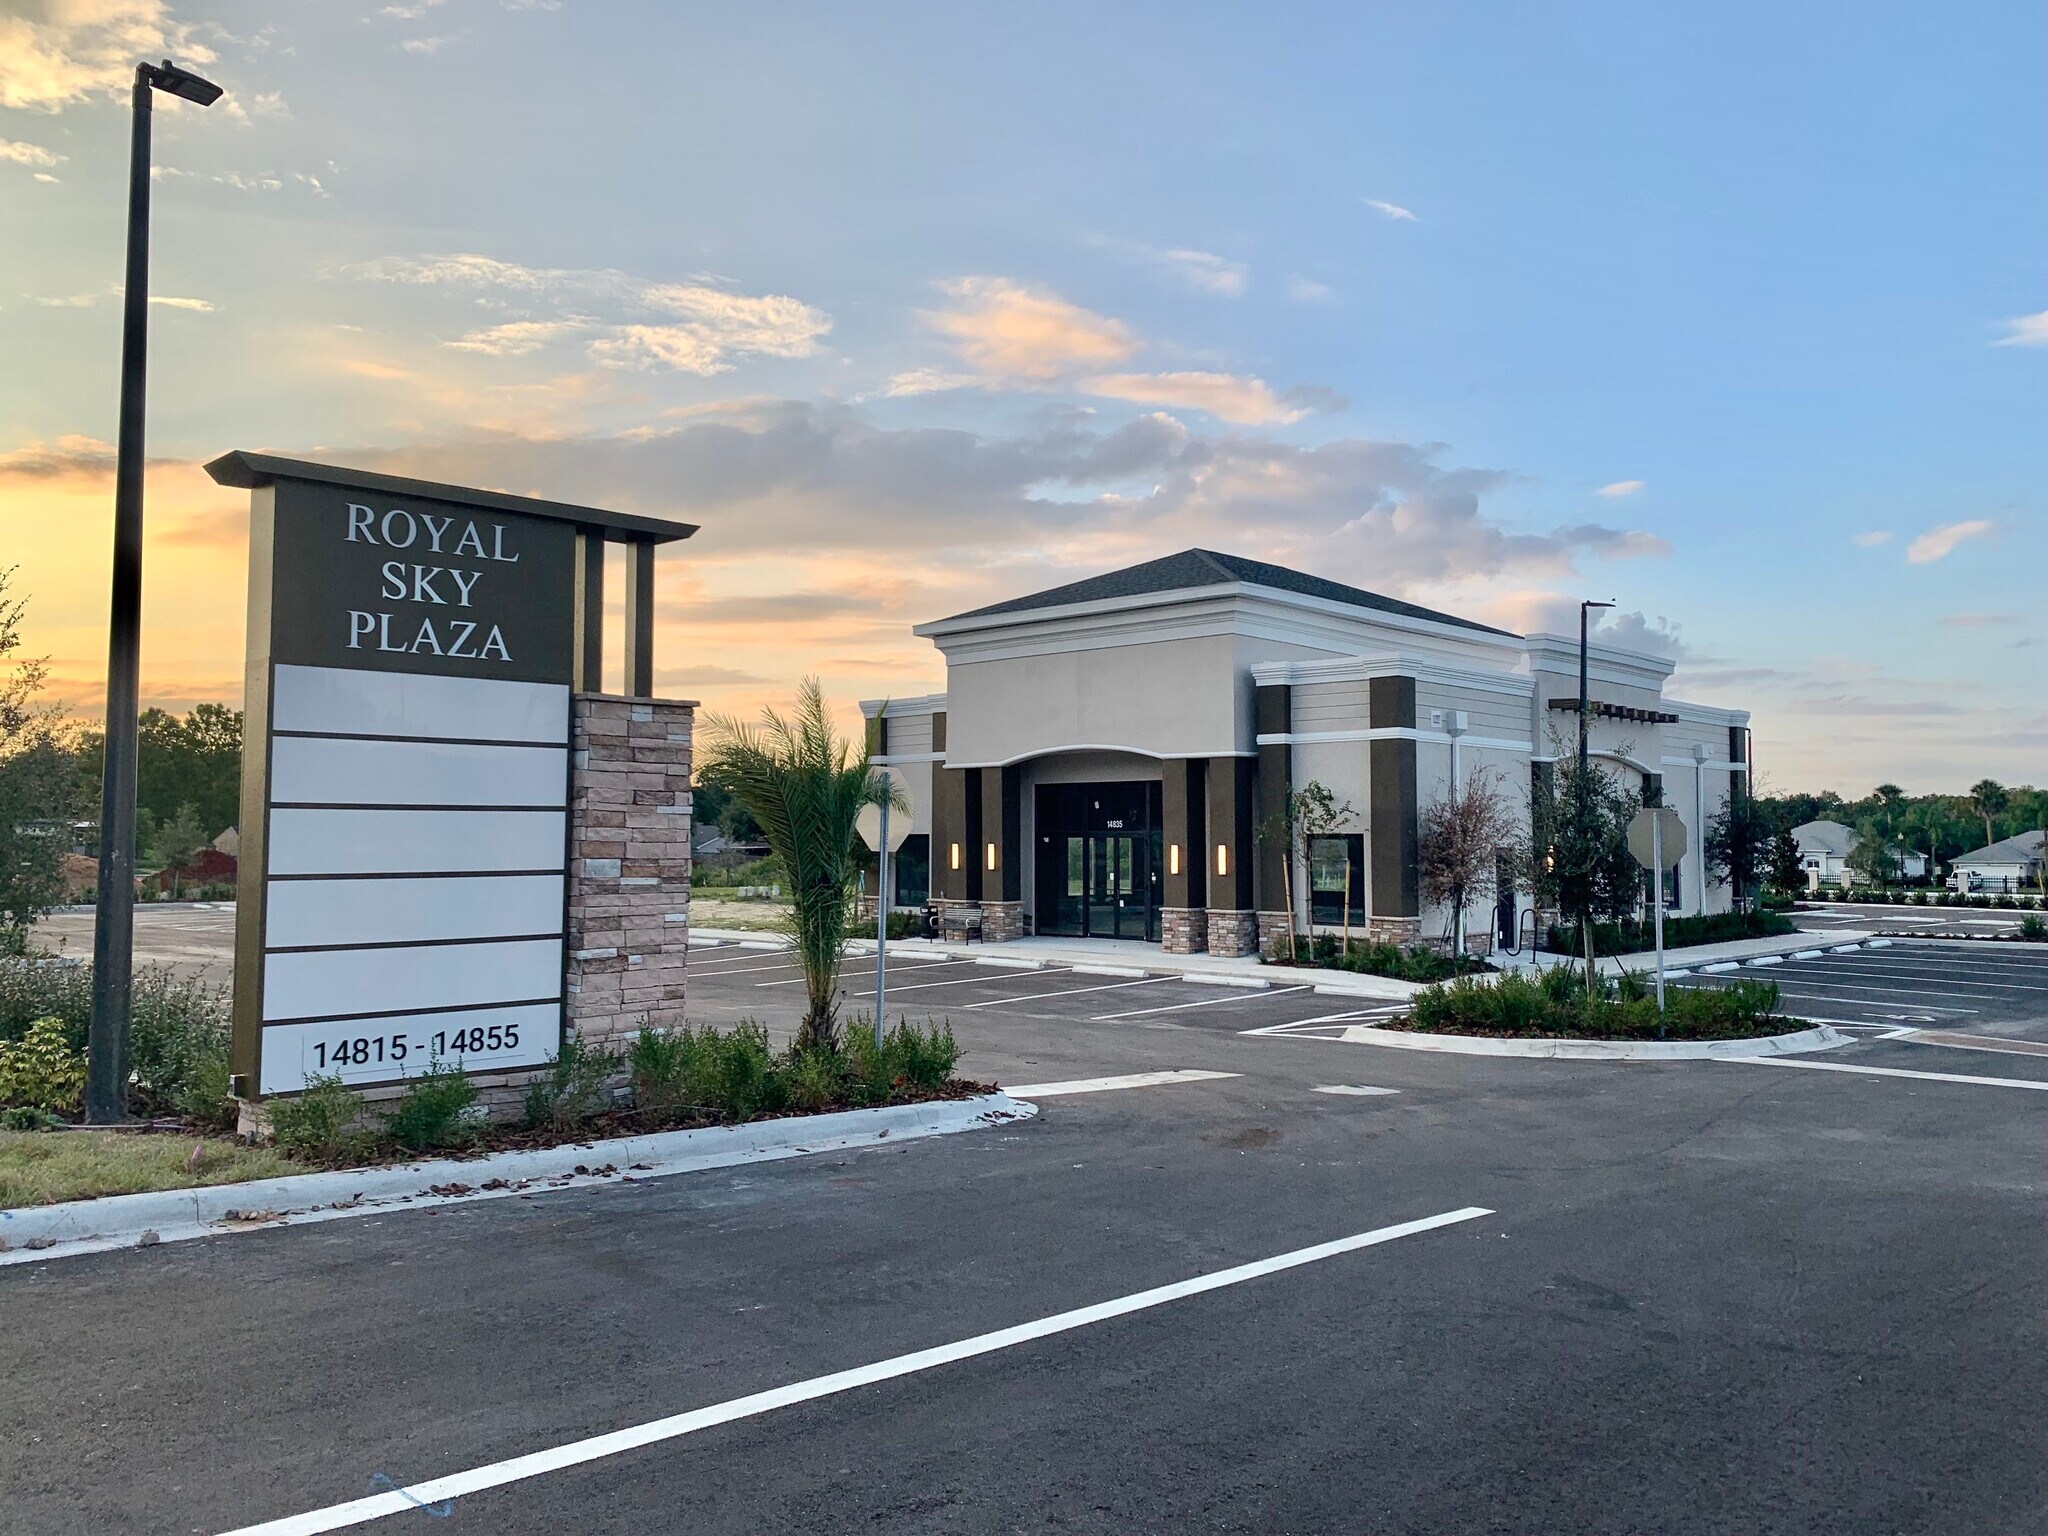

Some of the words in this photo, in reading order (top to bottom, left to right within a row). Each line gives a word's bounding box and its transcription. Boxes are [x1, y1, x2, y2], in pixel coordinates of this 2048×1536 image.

[344, 502, 520, 562] ROYAL
[382, 561, 483, 608] SKY
[345, 610, 514, 662] PLAZA
[1106, 820, 1123, 829] 14835
